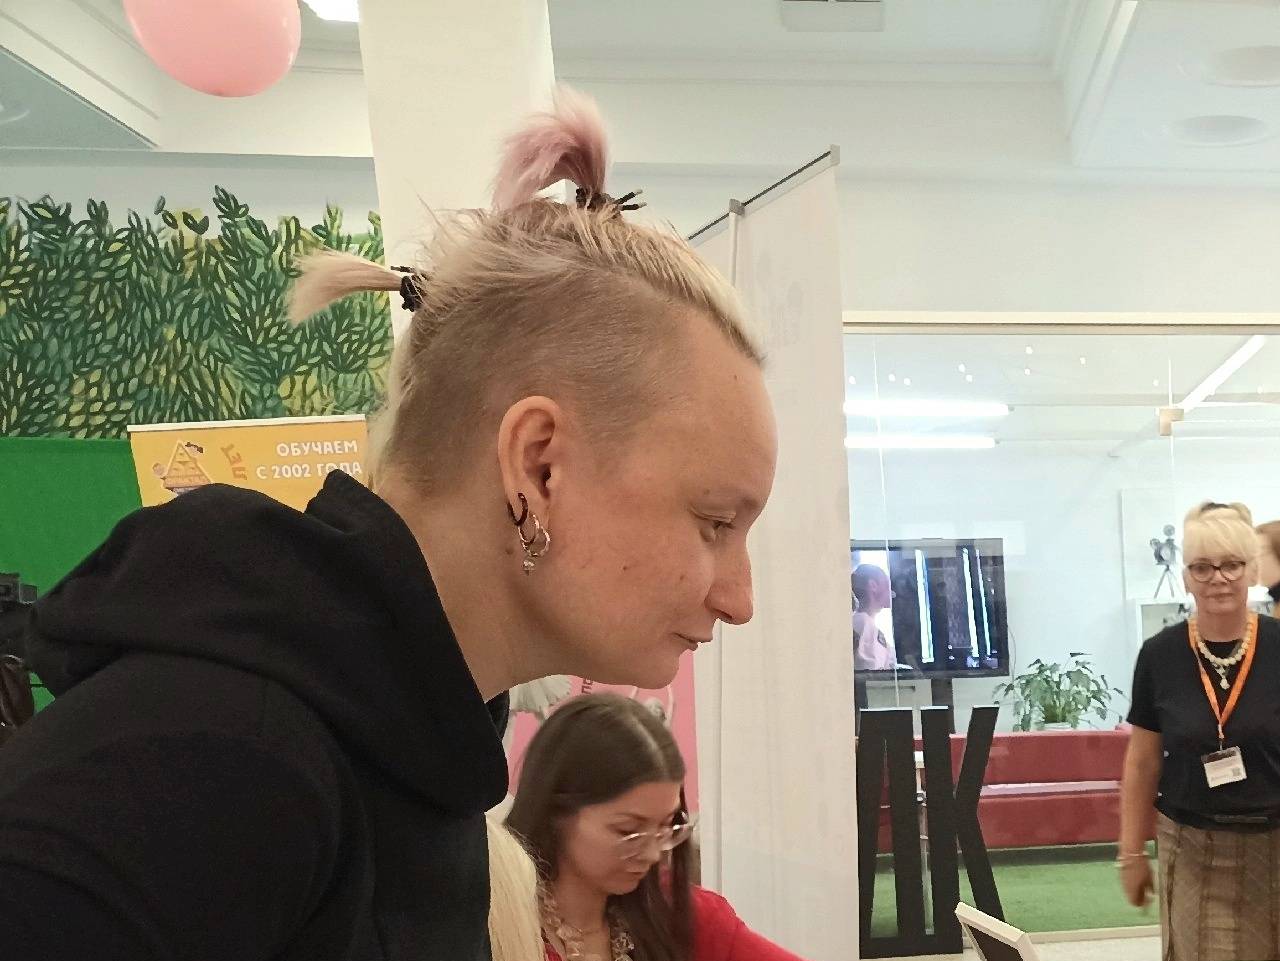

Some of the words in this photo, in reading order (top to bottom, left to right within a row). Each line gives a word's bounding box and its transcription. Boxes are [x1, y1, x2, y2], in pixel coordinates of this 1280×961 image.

[276, 440, 358, 457] ОБУЧАЕМ
[256, 466, 267, 480] С
[272, 463, 312, 479] 2002
[317, 461, 363, 478] ГОДА
